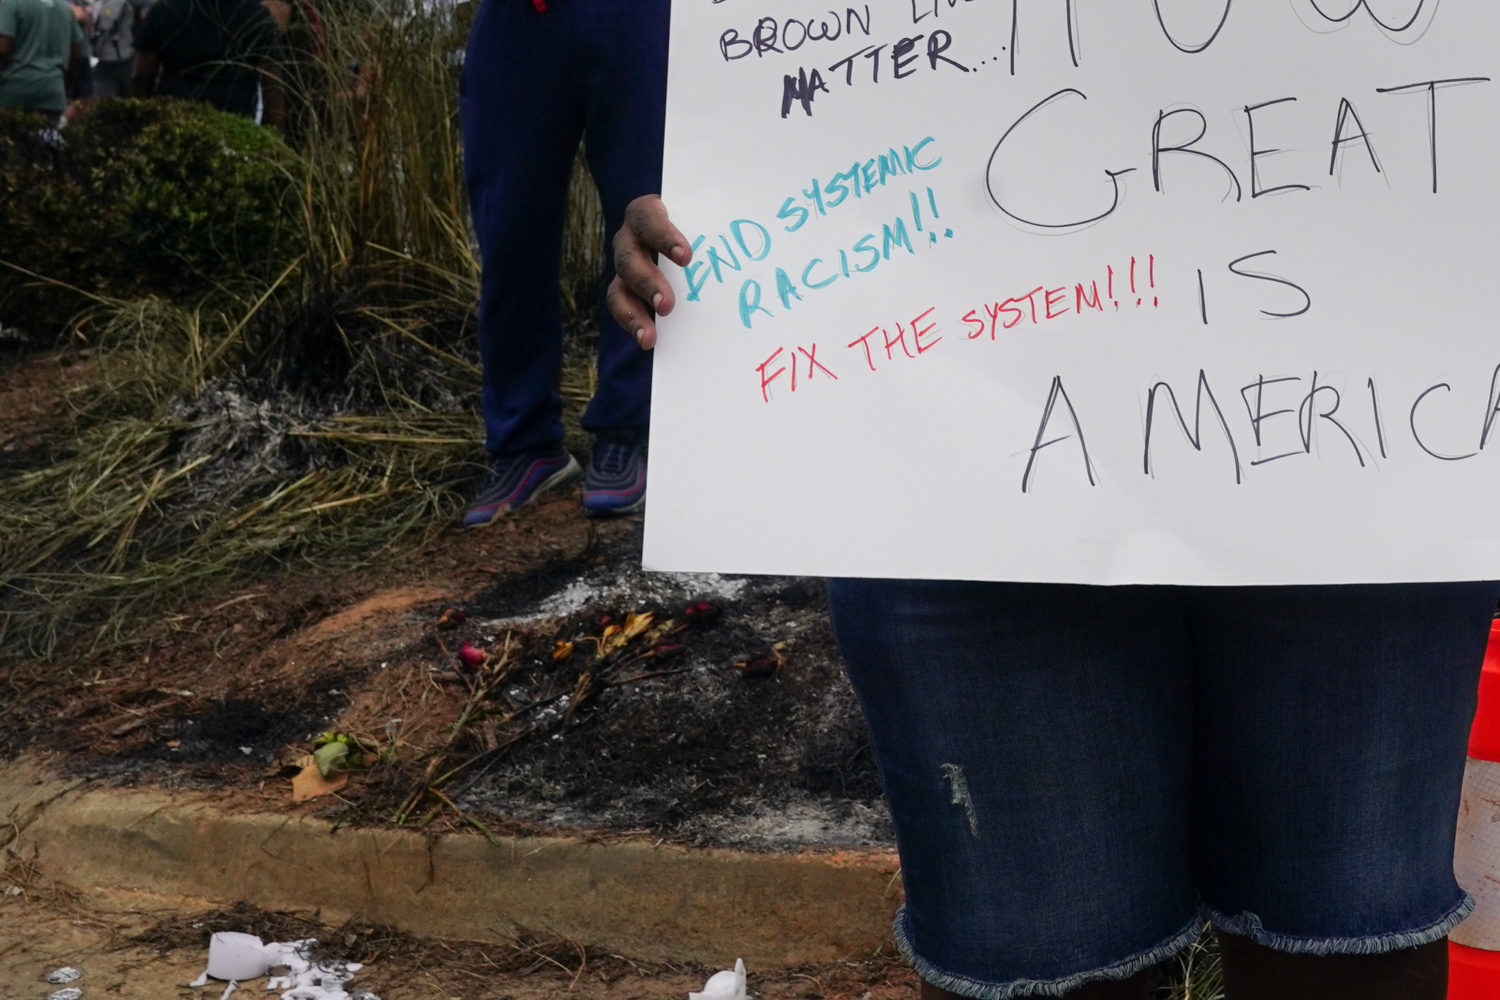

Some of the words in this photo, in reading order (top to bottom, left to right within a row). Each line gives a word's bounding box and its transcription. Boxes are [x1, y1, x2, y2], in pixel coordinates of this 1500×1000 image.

[719, 5, 872, 62] BROWN
[683, 218, 771, 302] END
[776, 135, 942, 233] SYSTEMIC
[985, 77, 1491, 230] GREAT
[738, 187, 954, 329] RACISM!!
[755, 342, 838, 403] FIX
[848, 306, 943, 372] THE
[962, 253, 1159, 341] SYSTEM!!!
[1197, 249, 1312, 325] IS
